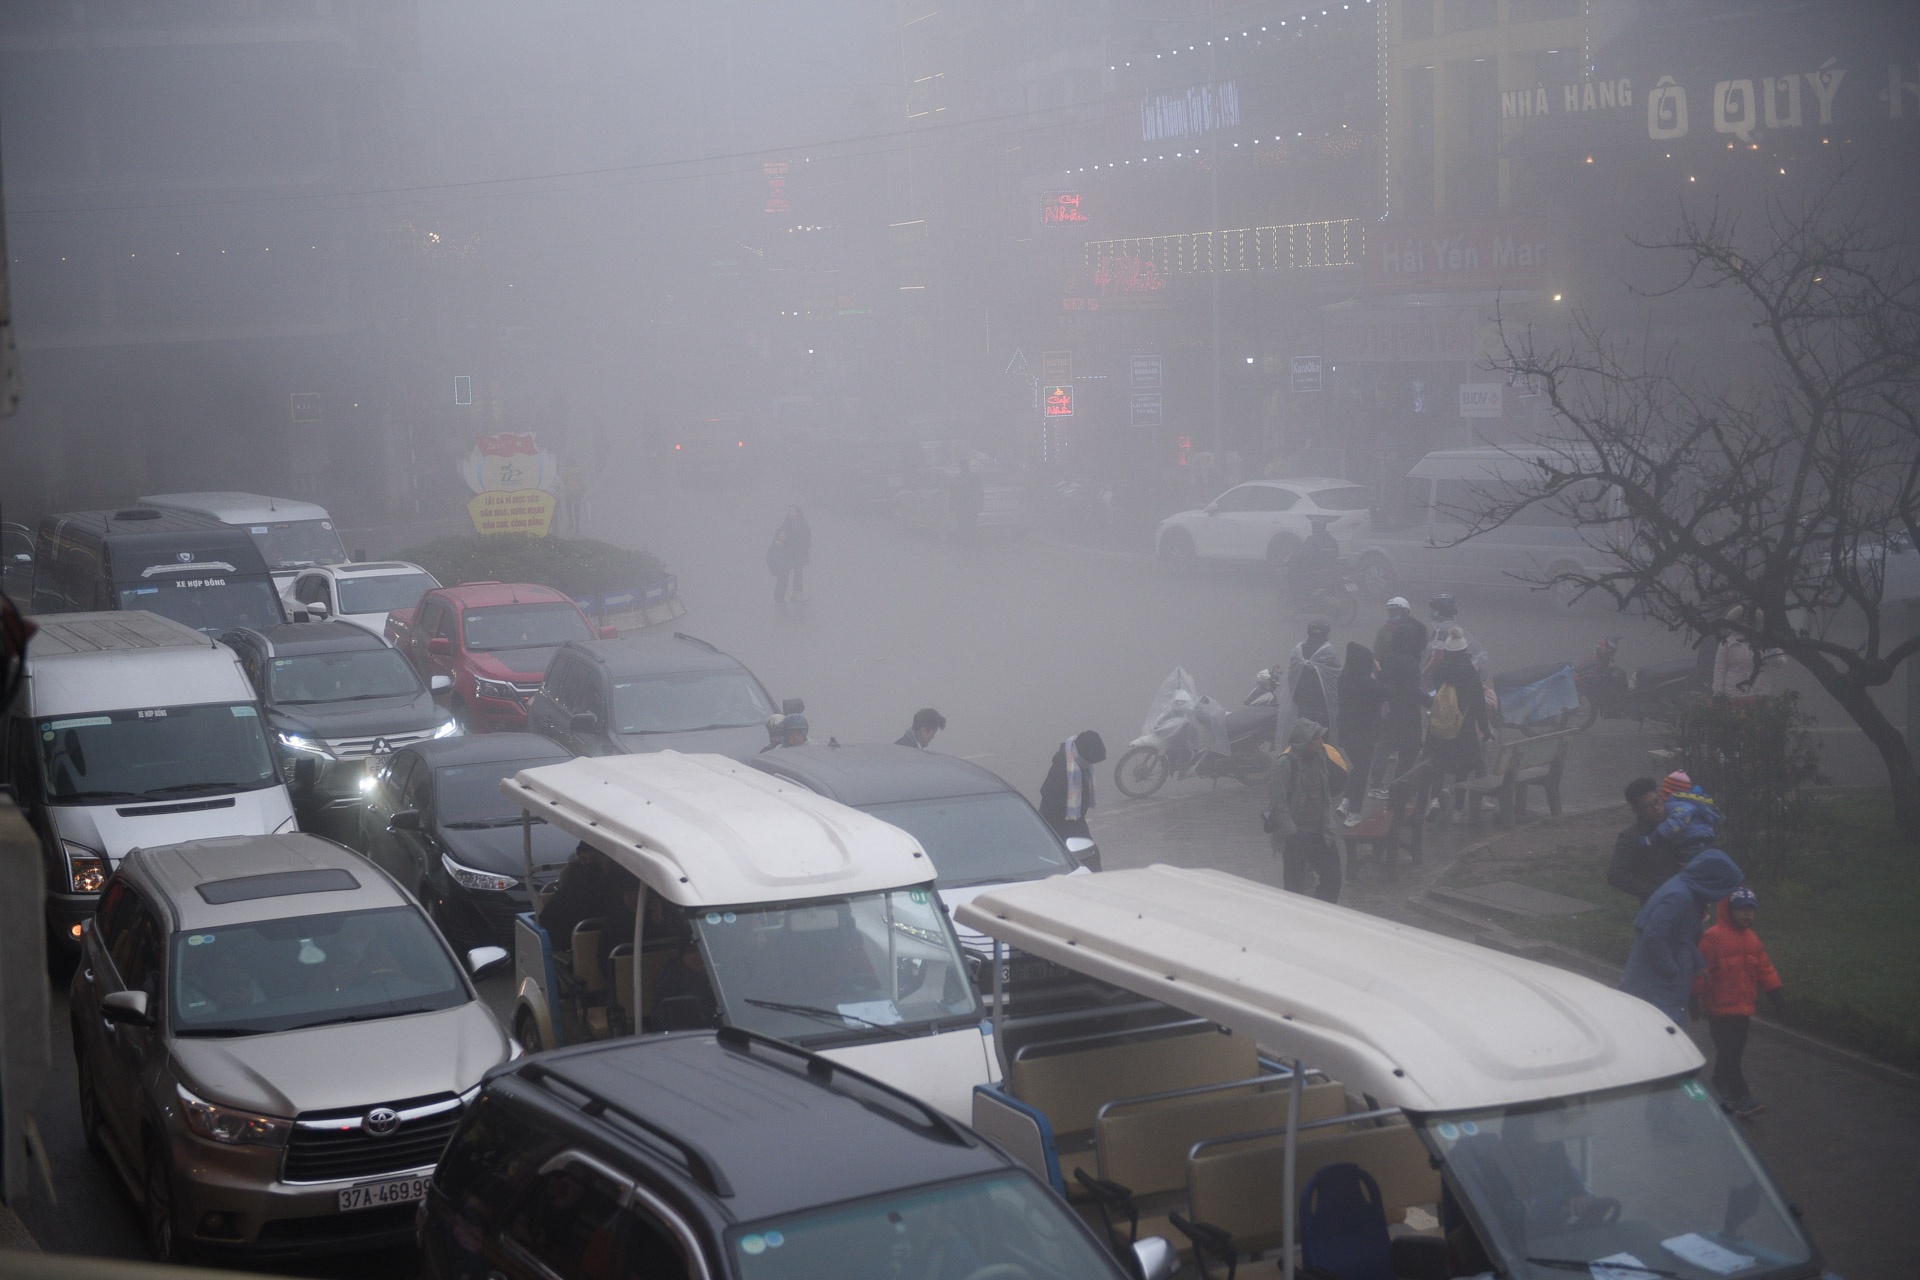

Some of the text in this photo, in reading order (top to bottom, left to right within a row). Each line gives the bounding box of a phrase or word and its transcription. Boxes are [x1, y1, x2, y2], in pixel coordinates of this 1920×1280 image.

[1502, 82, 1549, 119] NHÀ
[1564, 78, 1633, 113] HÀNG
[1647, 75, 1689, 141] Ô
[1713, 57, 1847, 143] QUÝ
[1382, 239, 1424, 273] Hải
[1431, 232, 1479, 270] Yến
[1463, 391, 1488, 405] BIDV
[187, 580, 203, 588] HỢP
[912, 892, 926, 902] 01
